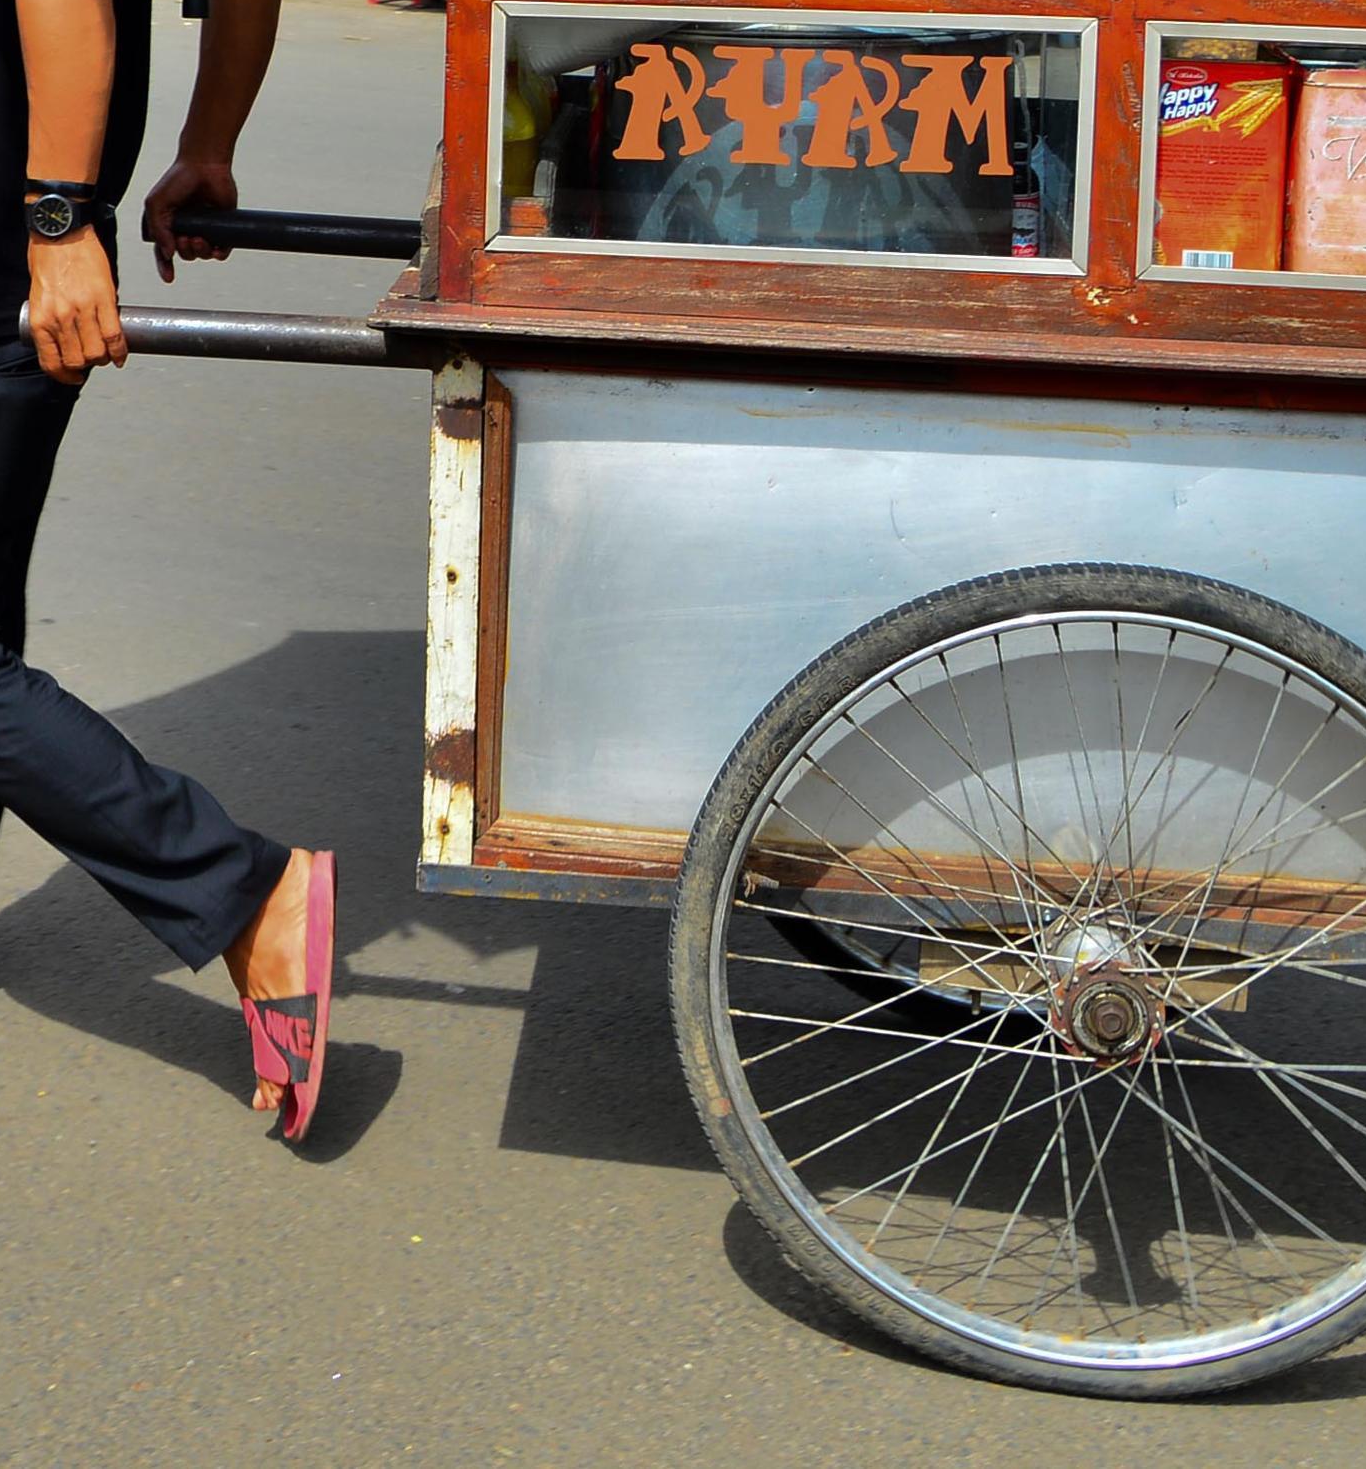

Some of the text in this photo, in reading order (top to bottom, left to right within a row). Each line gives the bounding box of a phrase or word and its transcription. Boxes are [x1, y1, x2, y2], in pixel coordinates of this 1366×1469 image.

[613, 44, 1014, 176] AYAM
[1164, 99, 1217, 120] Happy
[265, 1008, 313, 1061] NIKE
